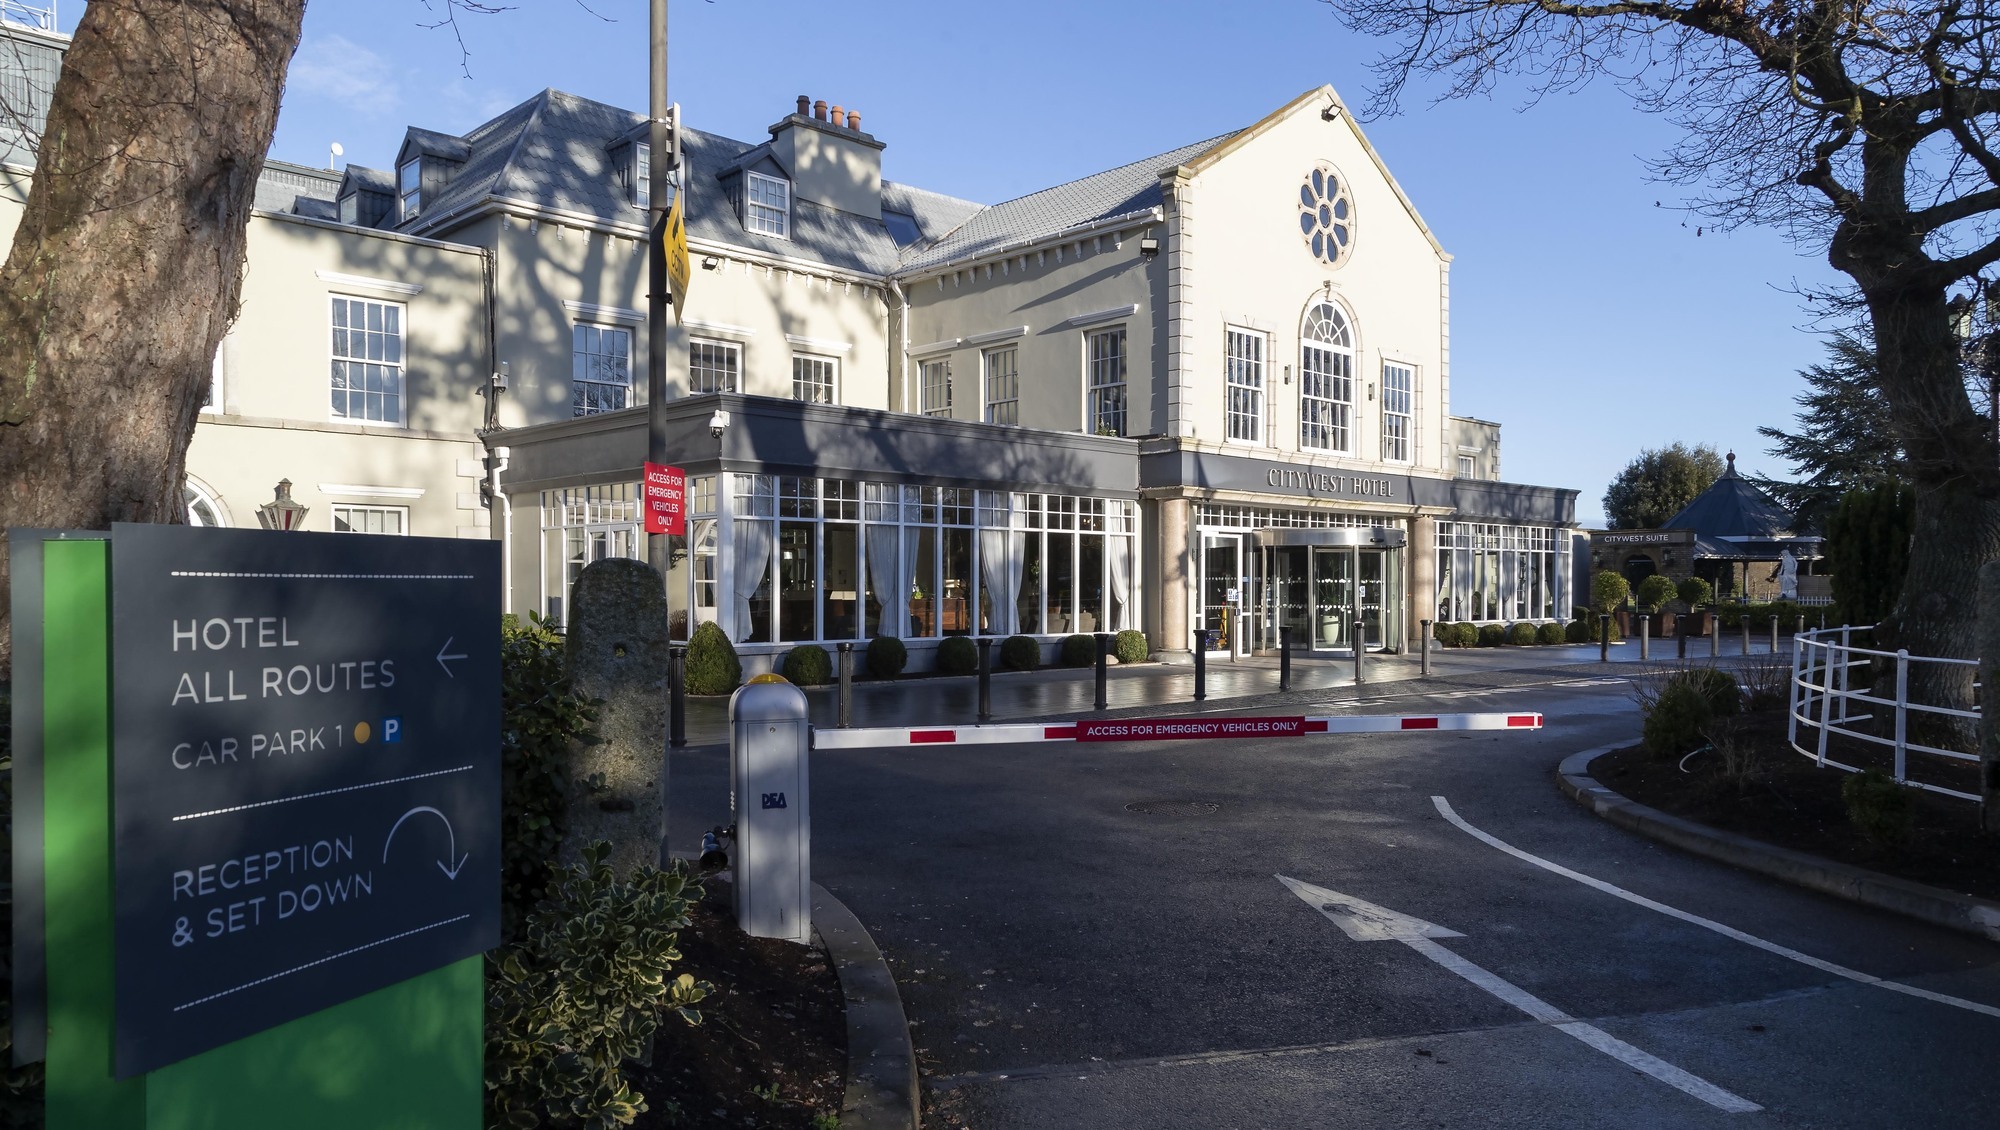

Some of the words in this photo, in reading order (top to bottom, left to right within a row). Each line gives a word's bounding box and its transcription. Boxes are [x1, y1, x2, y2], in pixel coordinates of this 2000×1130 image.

[648, 472, 670, 485] ACCESS
[670, 475, 683, 487] FOR
[1268, 468, 1345, 493] CITYWEST
[1351, 478, 1394, 497] HOTEL
[648, 486, 683, 500] EMERGENCY
[652, 501, 679, 513] VEHICLES
[657, 515, 673, 526] ONLY
[1604, 535, 1644, 543] CITYWEST
[1645, 534, 1669, 542] SUITE
[173, 616, 299, 652] HOTEL
[171, 669, 247, 706] ALL
[262, 659, 395, 698] ROUTES
[1086, 726, 1129, 736] ACCESS
[1131, 725, 1153, 735] FOR
[1155, 724, 1219, 734] EMERGENCY
[1221, 722, 1270, 732] VEHICLES
[1271, 721, 1299, 731] ONLY
[171, 737, 239, 770] CAR
[251, 726, 326, 759] PARK
[335, 724, 343, 748] 1
[385, 719, 399, 741] P
[761, 792, 788, 810] DEA
[173, 835, 353, 901] RECEPTION
[171, 916, 194, 947] &
[206, 896, 266, 938] SET
[278, 871, 372, 919] DOWN
